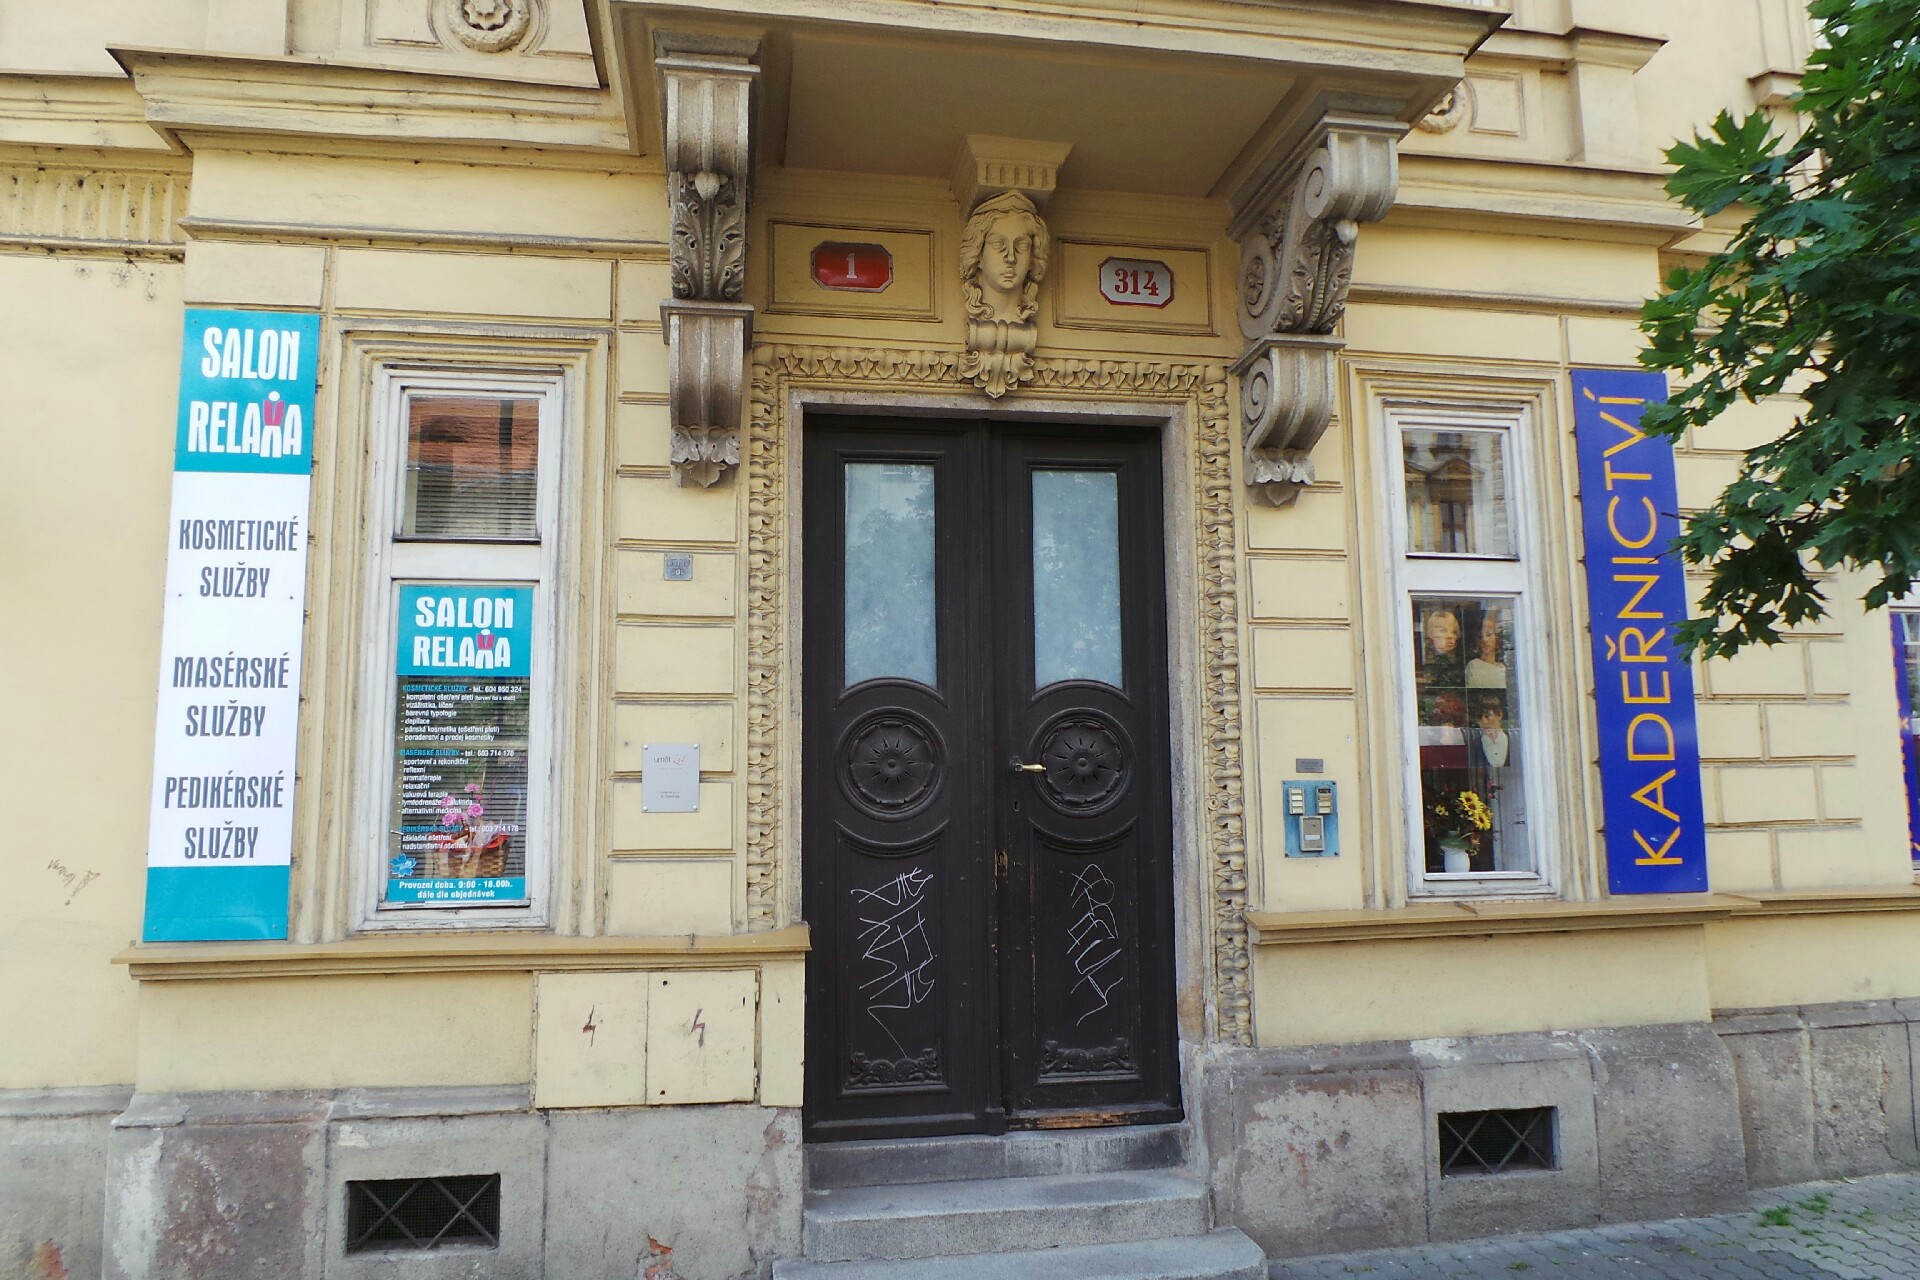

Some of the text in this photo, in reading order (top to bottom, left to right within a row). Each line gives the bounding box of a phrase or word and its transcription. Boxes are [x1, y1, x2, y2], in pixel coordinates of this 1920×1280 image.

[845, 252, 858, 279] 1
[1113, 268, 1160, 297] 314
[201, 327, 301, 381] SALON
[178, 515, 299, 551] KOSMETICKÉ
[199, 561, 271, 598] SLUŽBY
[414, 596, 514, 629] SALON
[1583, 386, 1684, 867] KADEŘNICTVÍ
[172, 651, 290, 689] MASÉRSKÉ
[185, 699, 267, 737] SLUŽBY
[430, 710, 458, 718] typologie
[164, 770, 285, 809] PEDIKÉRSKÉ
[184, 820, 259, 860] SLUŽBY
[399, 880, 434, 889] Provozní
[417, 890, 496, 899] dále dle objednávek
